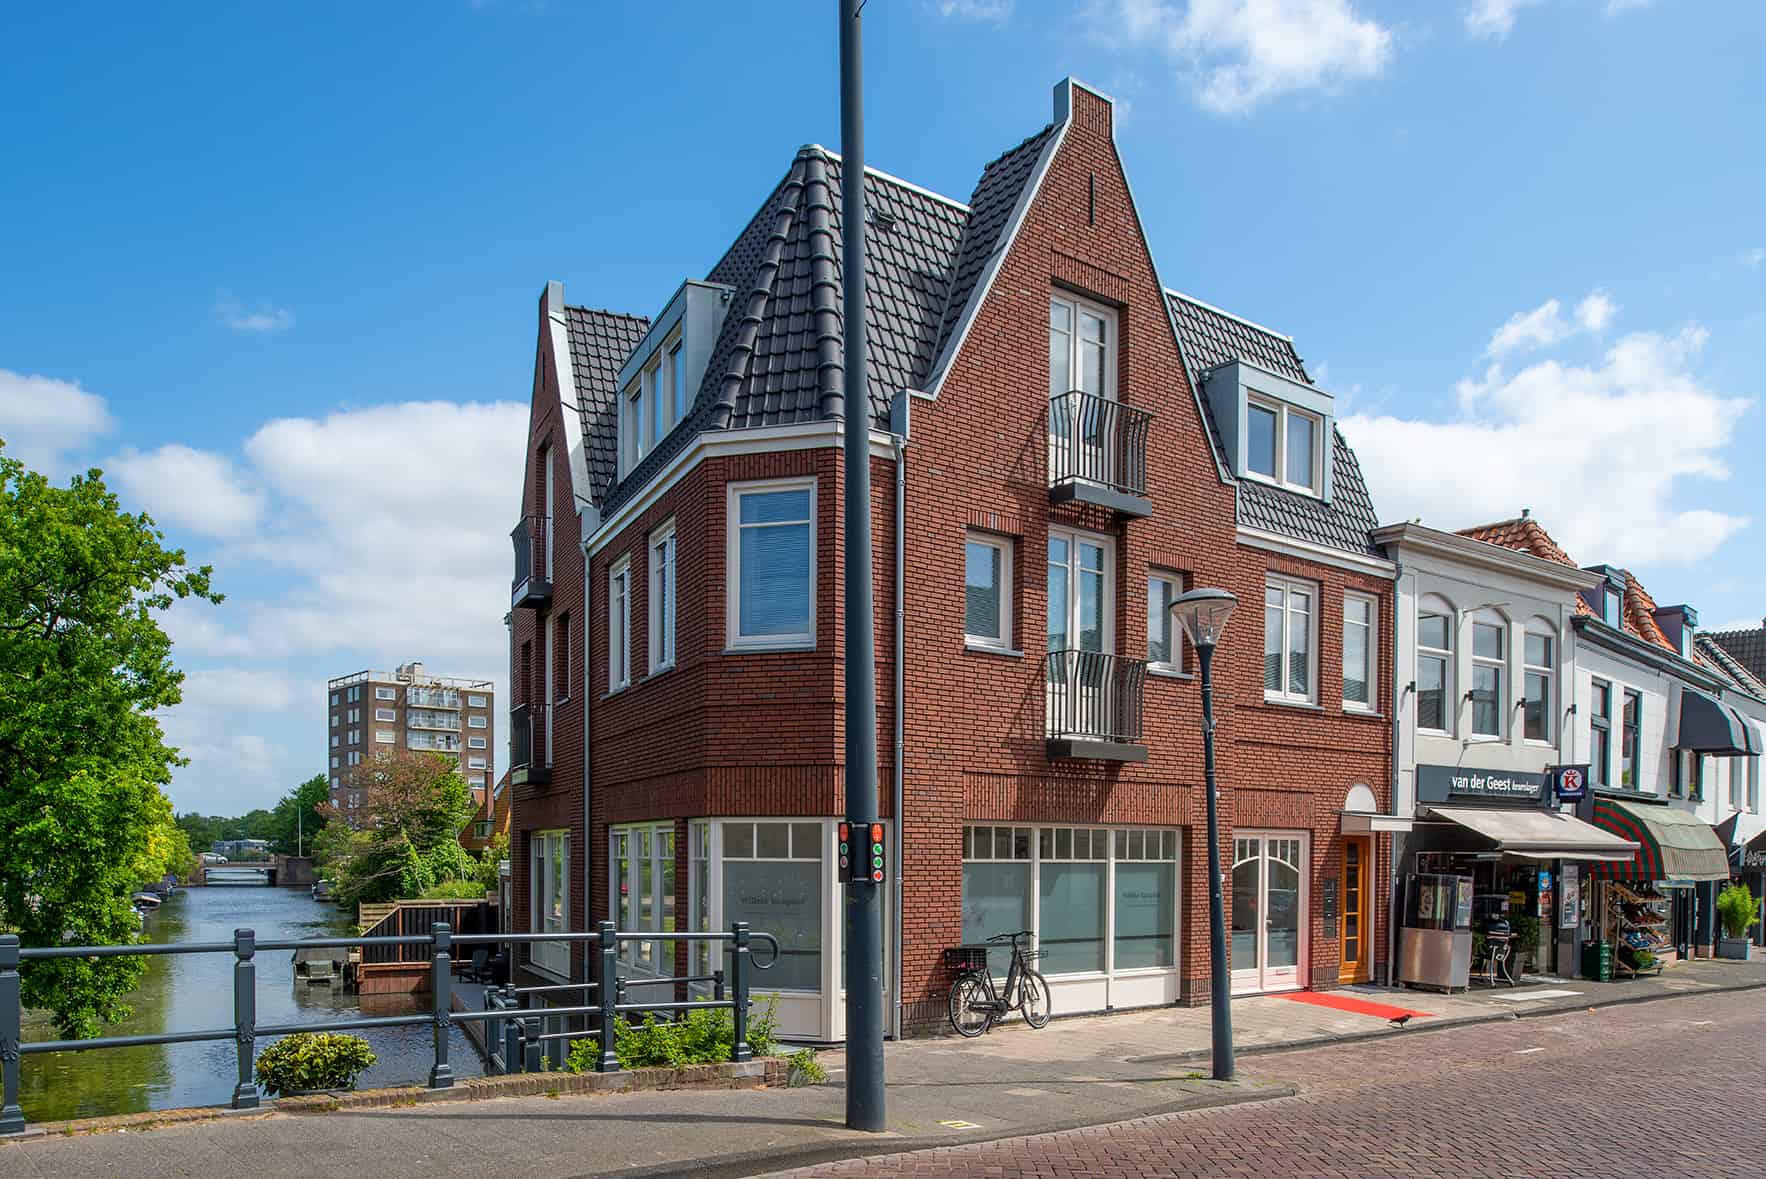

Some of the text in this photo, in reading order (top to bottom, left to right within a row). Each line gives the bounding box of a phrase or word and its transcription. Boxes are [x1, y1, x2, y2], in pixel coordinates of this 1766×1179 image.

[1452, 776, 1468, 788] van
[1471, 774, 1485, 789] der
[1487, 776, 1511, 791] Geest
